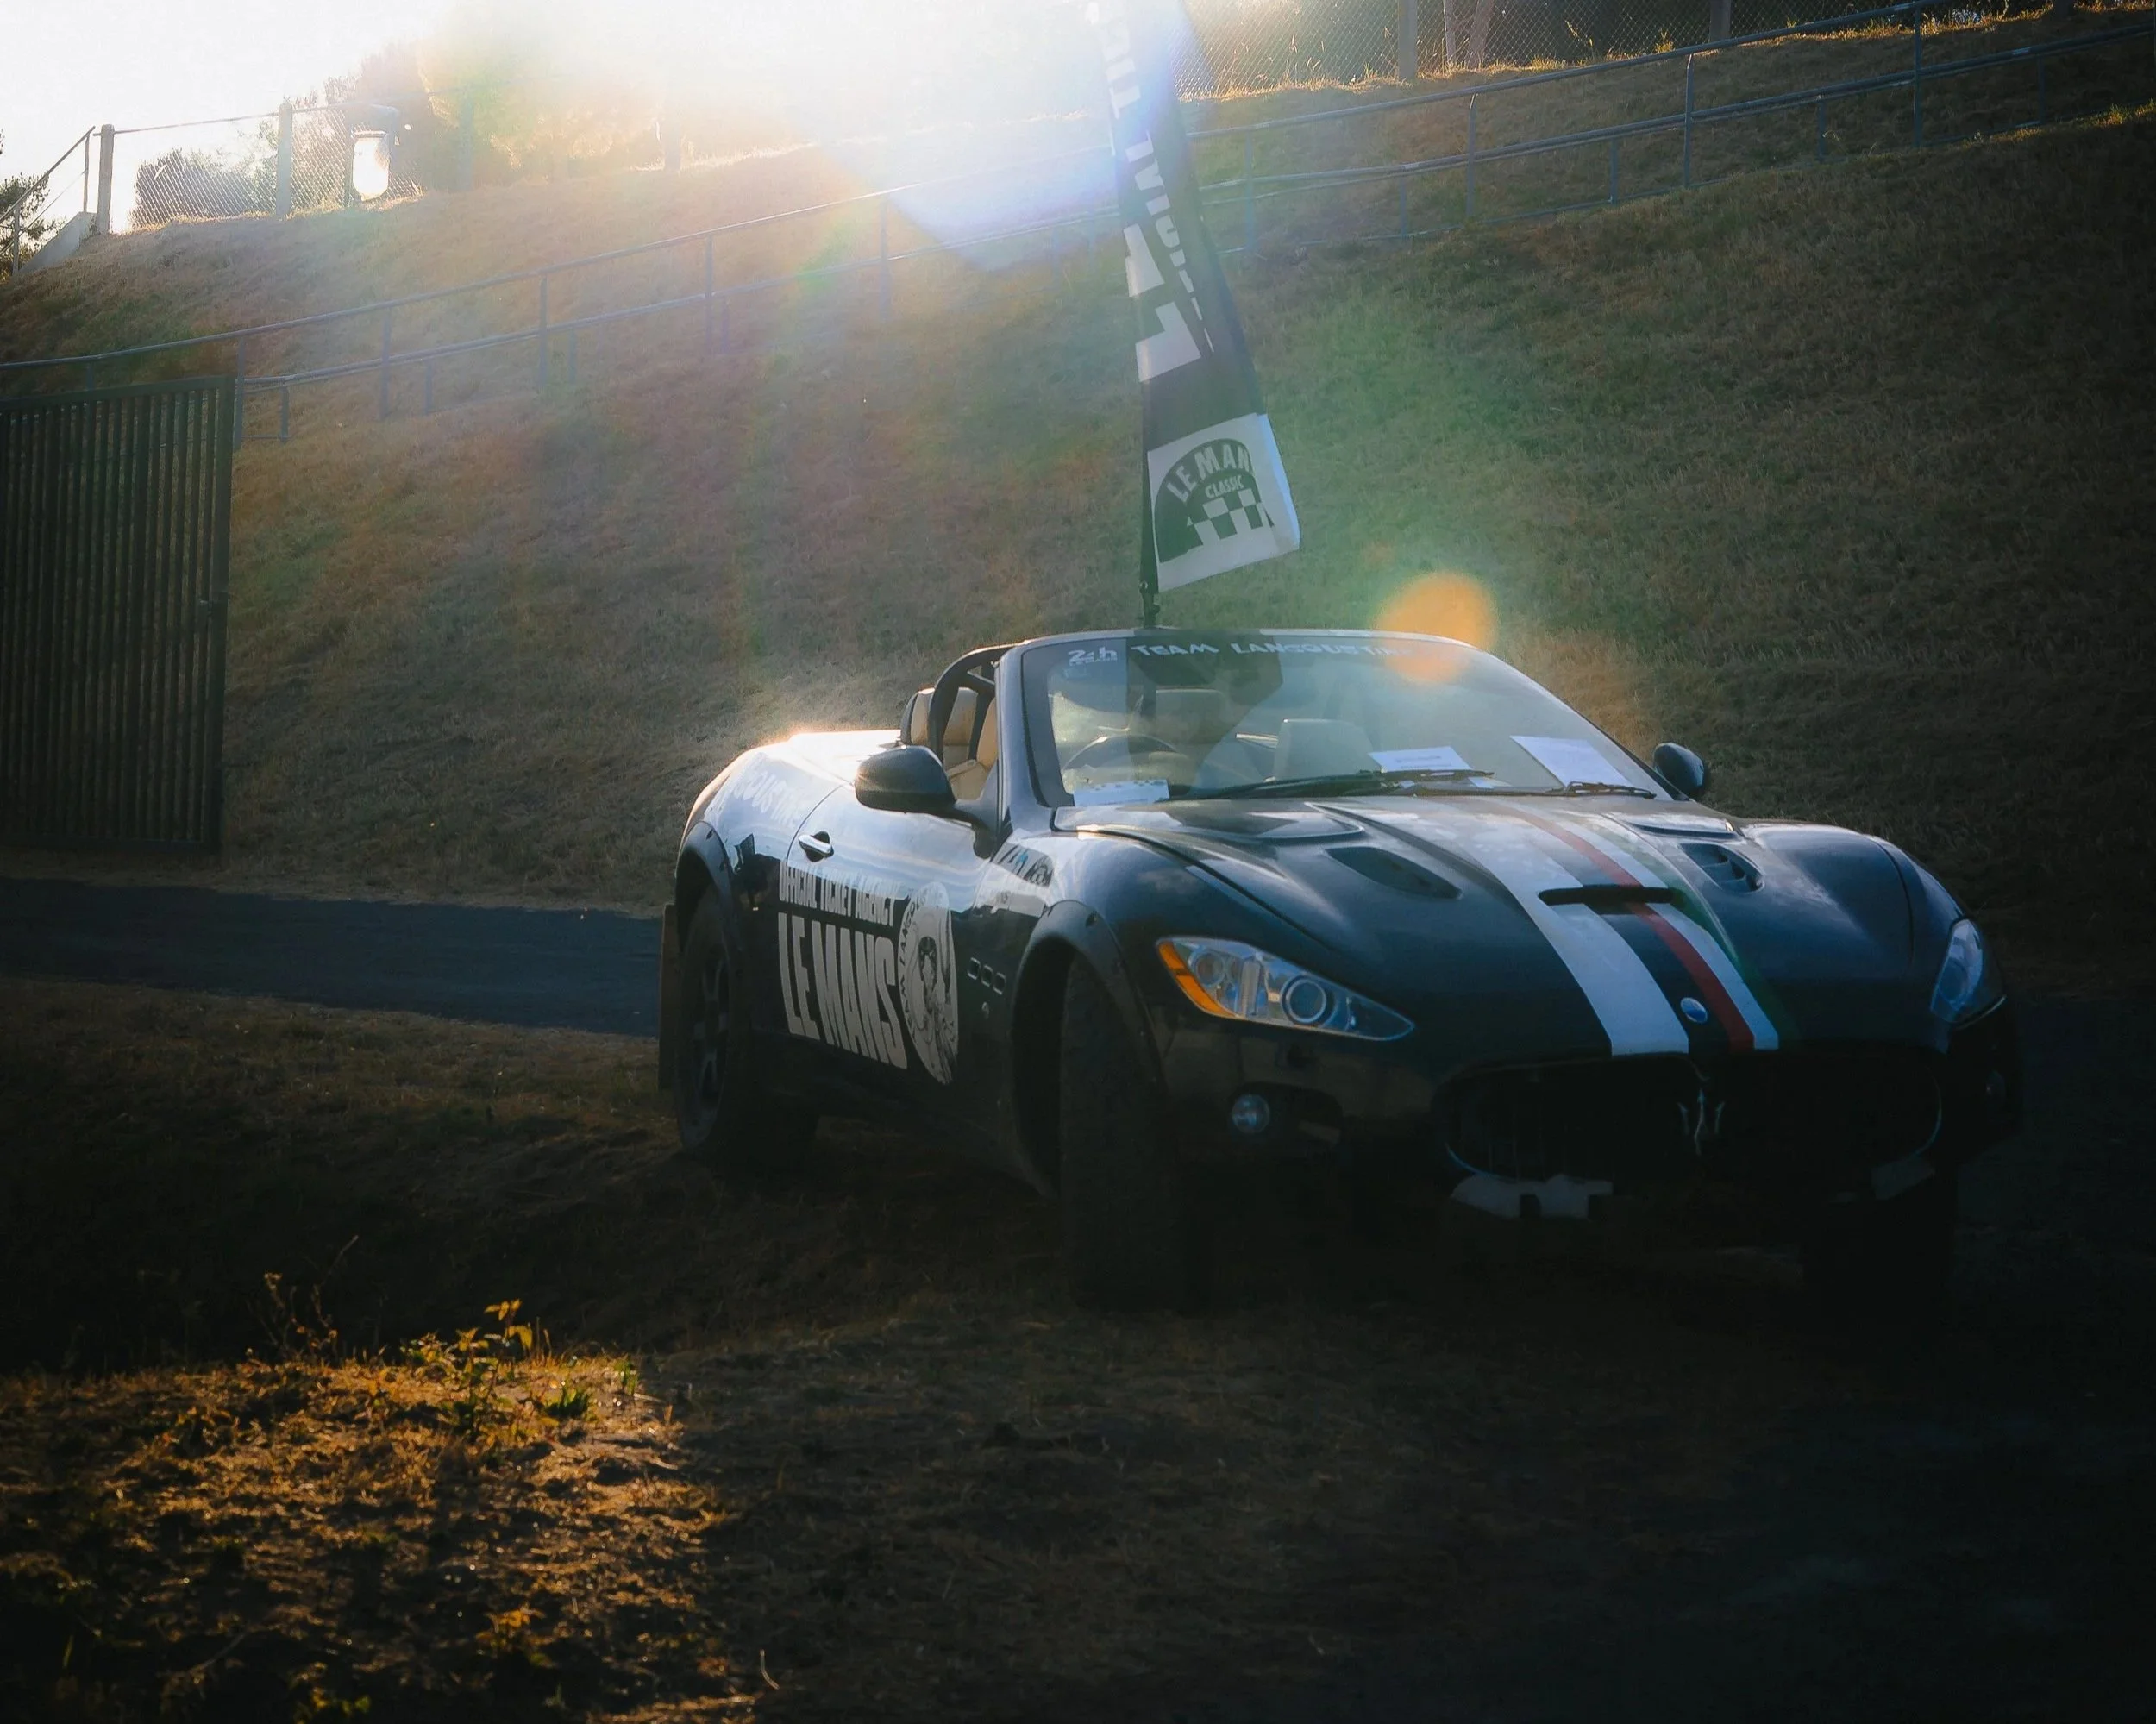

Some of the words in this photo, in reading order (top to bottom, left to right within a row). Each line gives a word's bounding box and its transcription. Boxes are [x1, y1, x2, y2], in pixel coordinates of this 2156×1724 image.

[1167, 466, 1198, 503] LE
[1194, 443, 1255, 480] MAN
[1205, 475, 1244, 498] CLASSIC
[1131, 643, 1220, 656] TEAM
[779, 861, 818, 908] OFFICIAL
[820, 869, 852, 918] TICKET
[855, 876, 899, 927] AGENCY
[778, 912, 820, 1040] LE
[812, 920, 907, 1069] MANS
